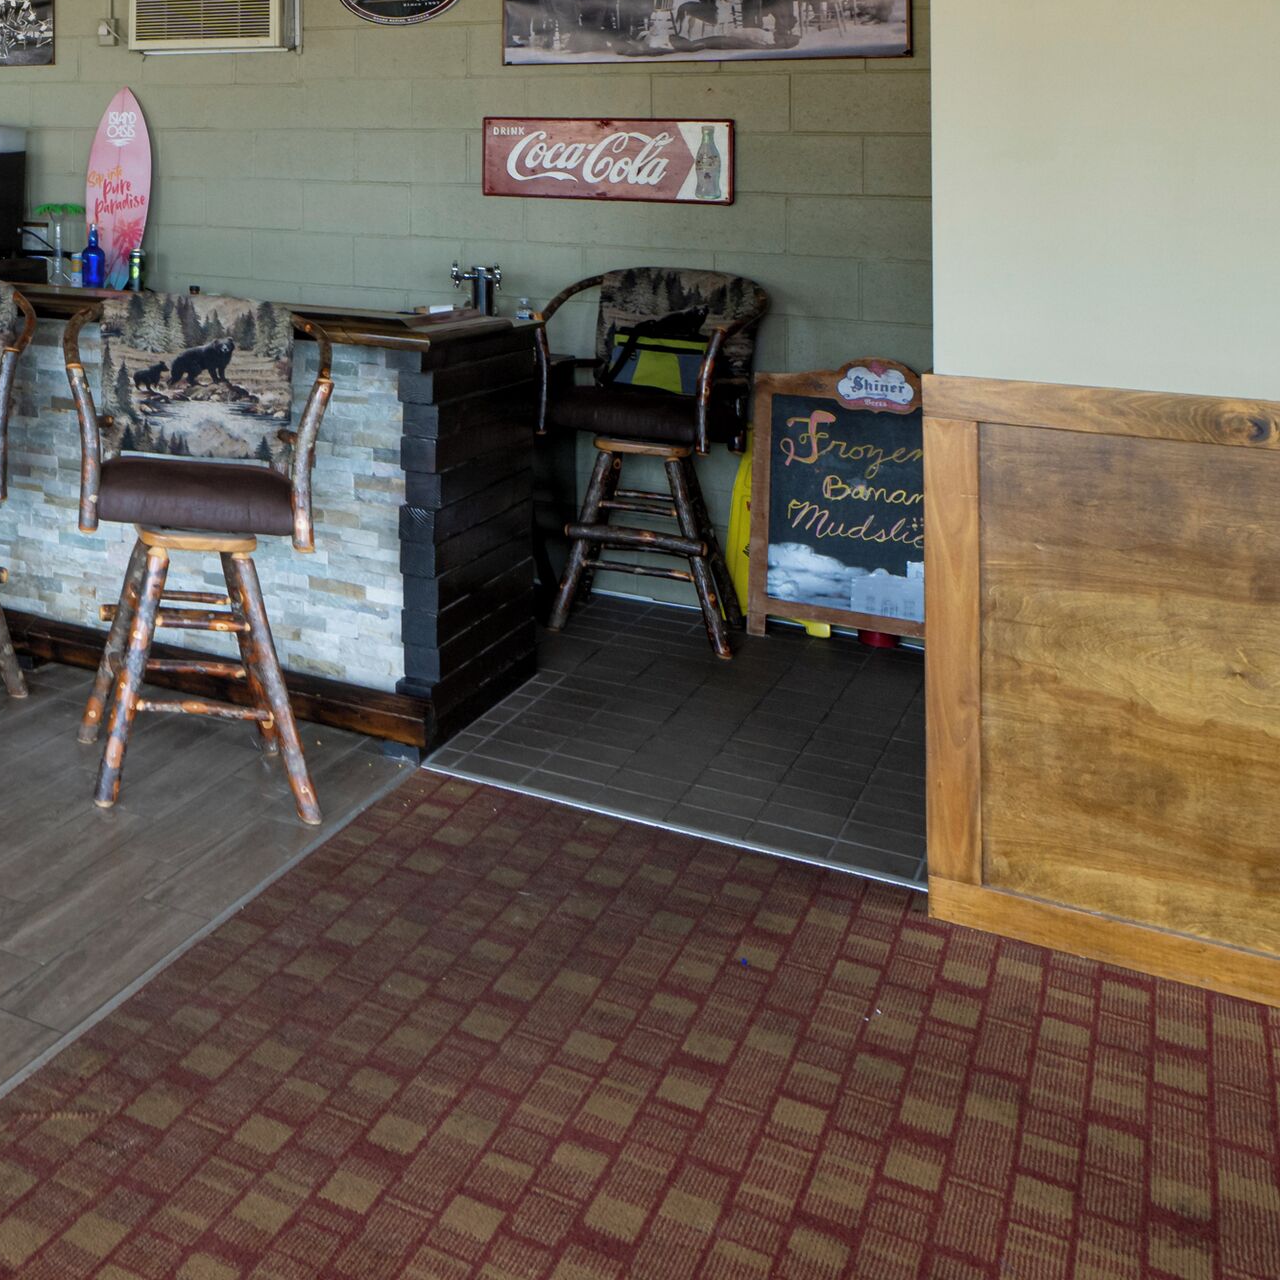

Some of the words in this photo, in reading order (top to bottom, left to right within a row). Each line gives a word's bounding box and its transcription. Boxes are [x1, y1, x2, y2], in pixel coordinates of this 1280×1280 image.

[108, 111, 137, 125] ISLAND
[107, 125, 136, 138] OASIS
[493, 126, 525, 136] DRINK
[506, 130, 674, 185] Coca-Cola
[850, 375, 905, 393] Shiner
